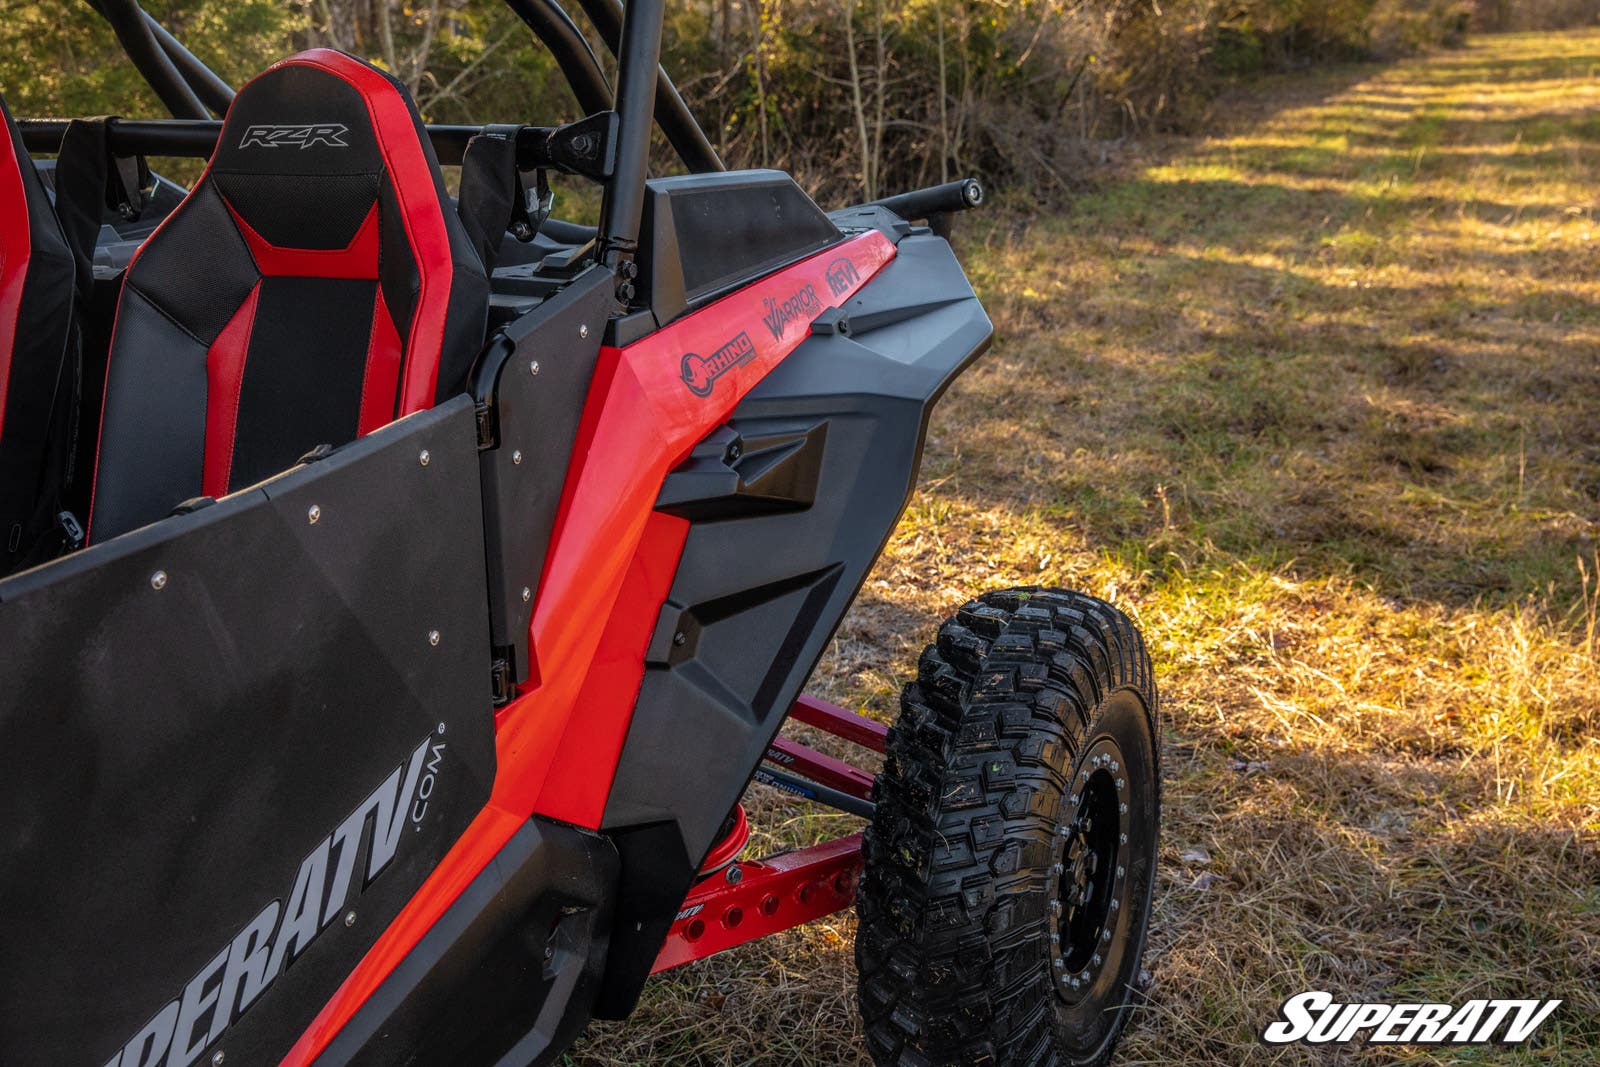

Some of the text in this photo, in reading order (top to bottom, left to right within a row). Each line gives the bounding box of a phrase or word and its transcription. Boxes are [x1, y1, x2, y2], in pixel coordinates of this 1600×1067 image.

[239, 123, 349, 149] RZR
[763, 284, 818, 343] WARRIOR
[703, 334, 753, 379] RHINO
[103, 736, 432, 1067] PERATV
